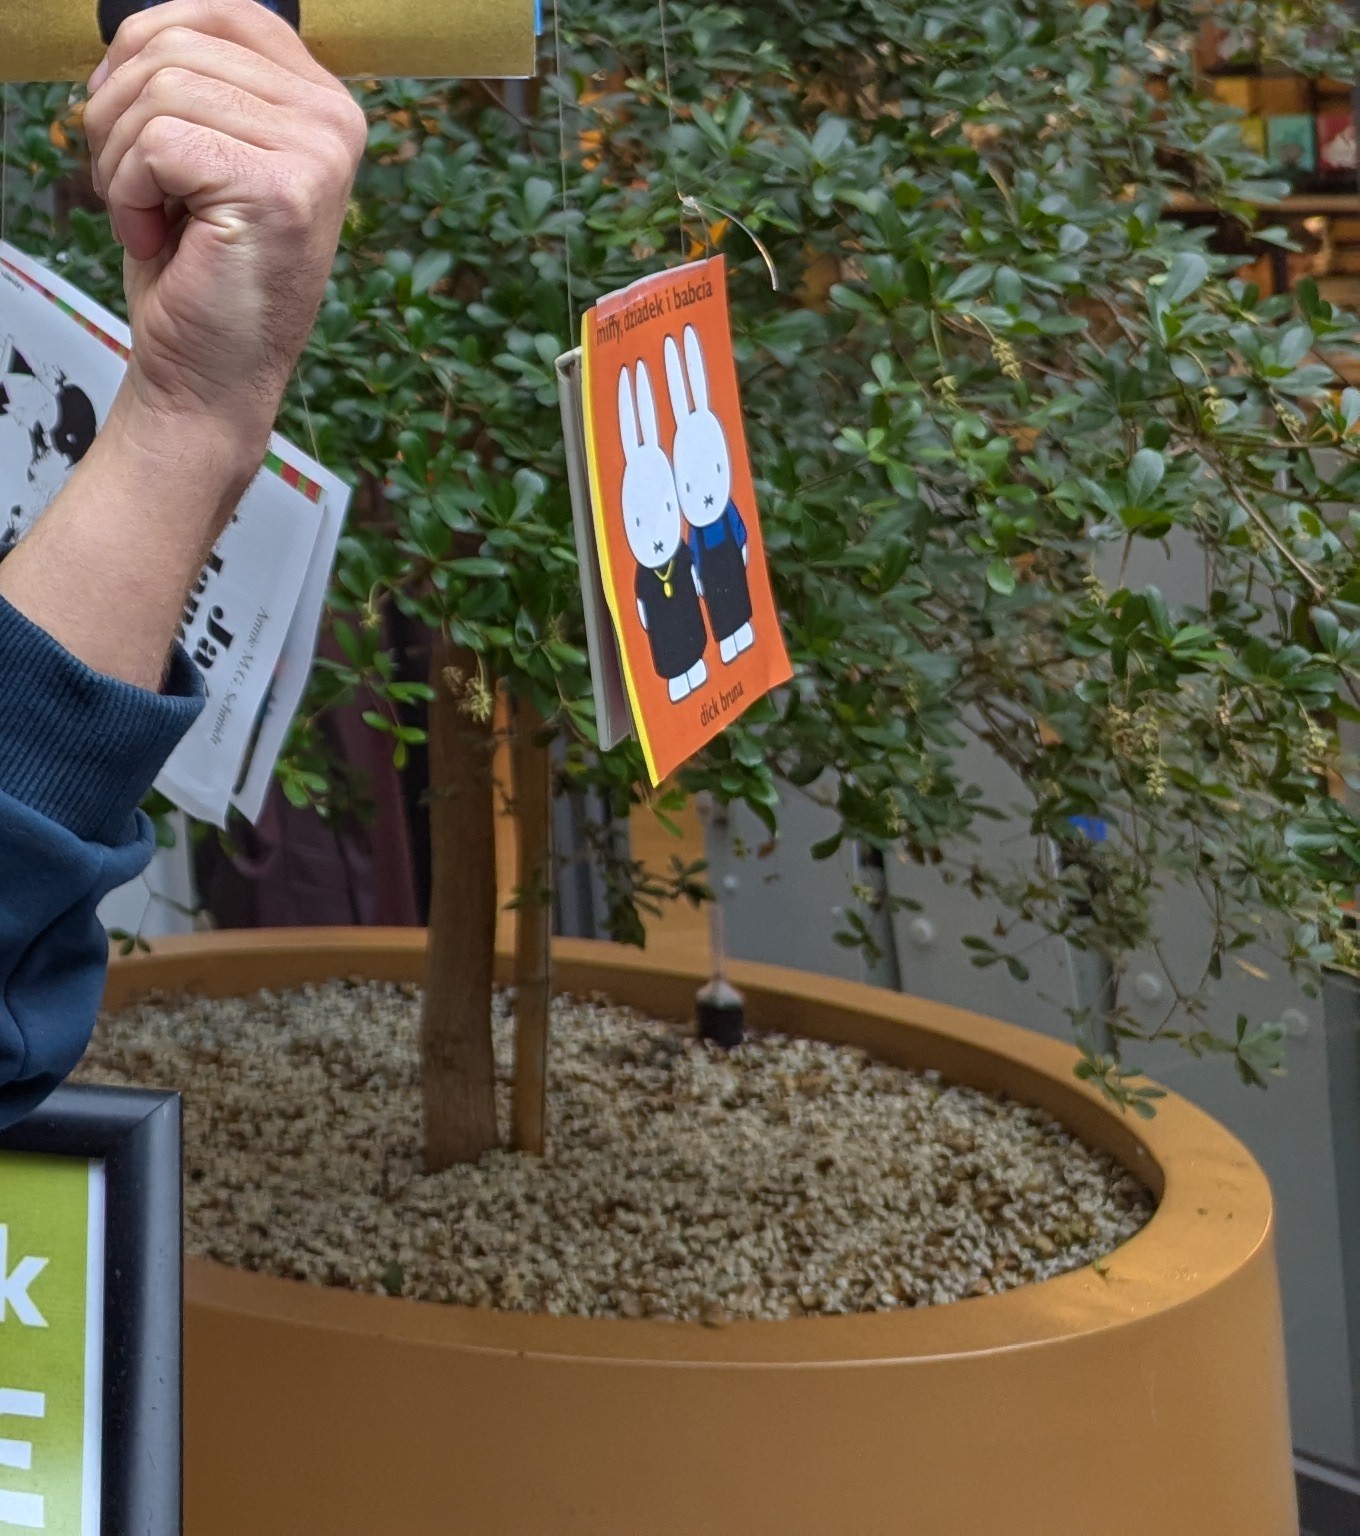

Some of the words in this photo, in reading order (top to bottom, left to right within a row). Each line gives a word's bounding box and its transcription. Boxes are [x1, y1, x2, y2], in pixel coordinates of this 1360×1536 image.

[623, 292, 665, 332] dziadek
[665, 289, 672, 313] i
[672, 276, 714, 311] babcia
[700, 697, 720, 727] dick
[718, 681, 744, 712] bruna
